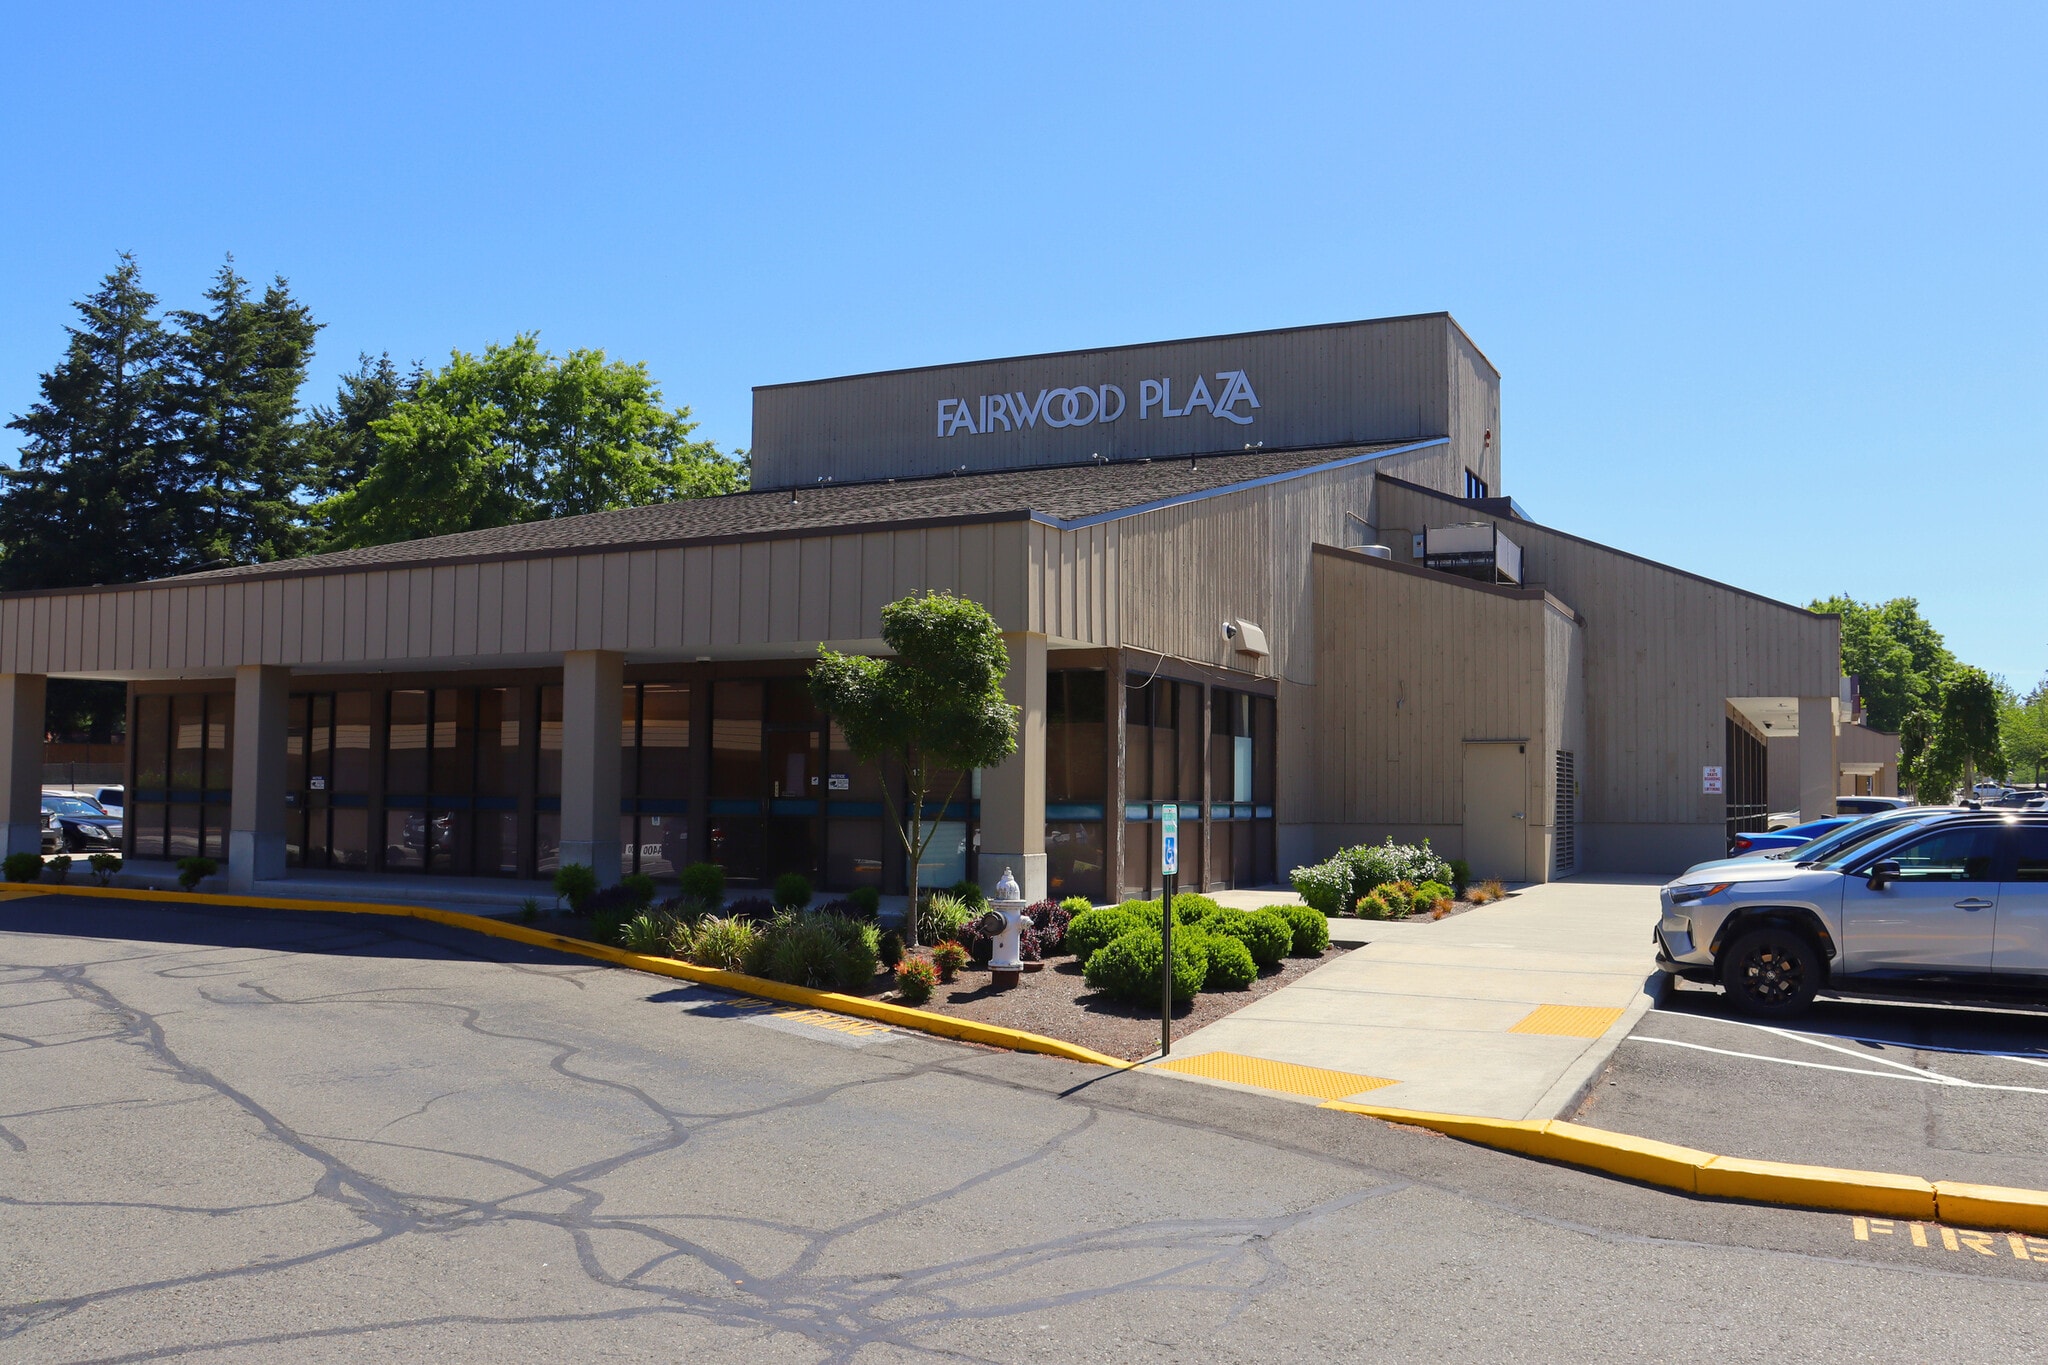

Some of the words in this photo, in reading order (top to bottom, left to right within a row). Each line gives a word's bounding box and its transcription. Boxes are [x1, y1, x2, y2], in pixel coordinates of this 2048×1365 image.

[937, 384, 1126, 438] FAIRWOOD
[1139, 369, 1261, 425] PLAZA
[1853, 1216, 2048, 1263] FIRE
